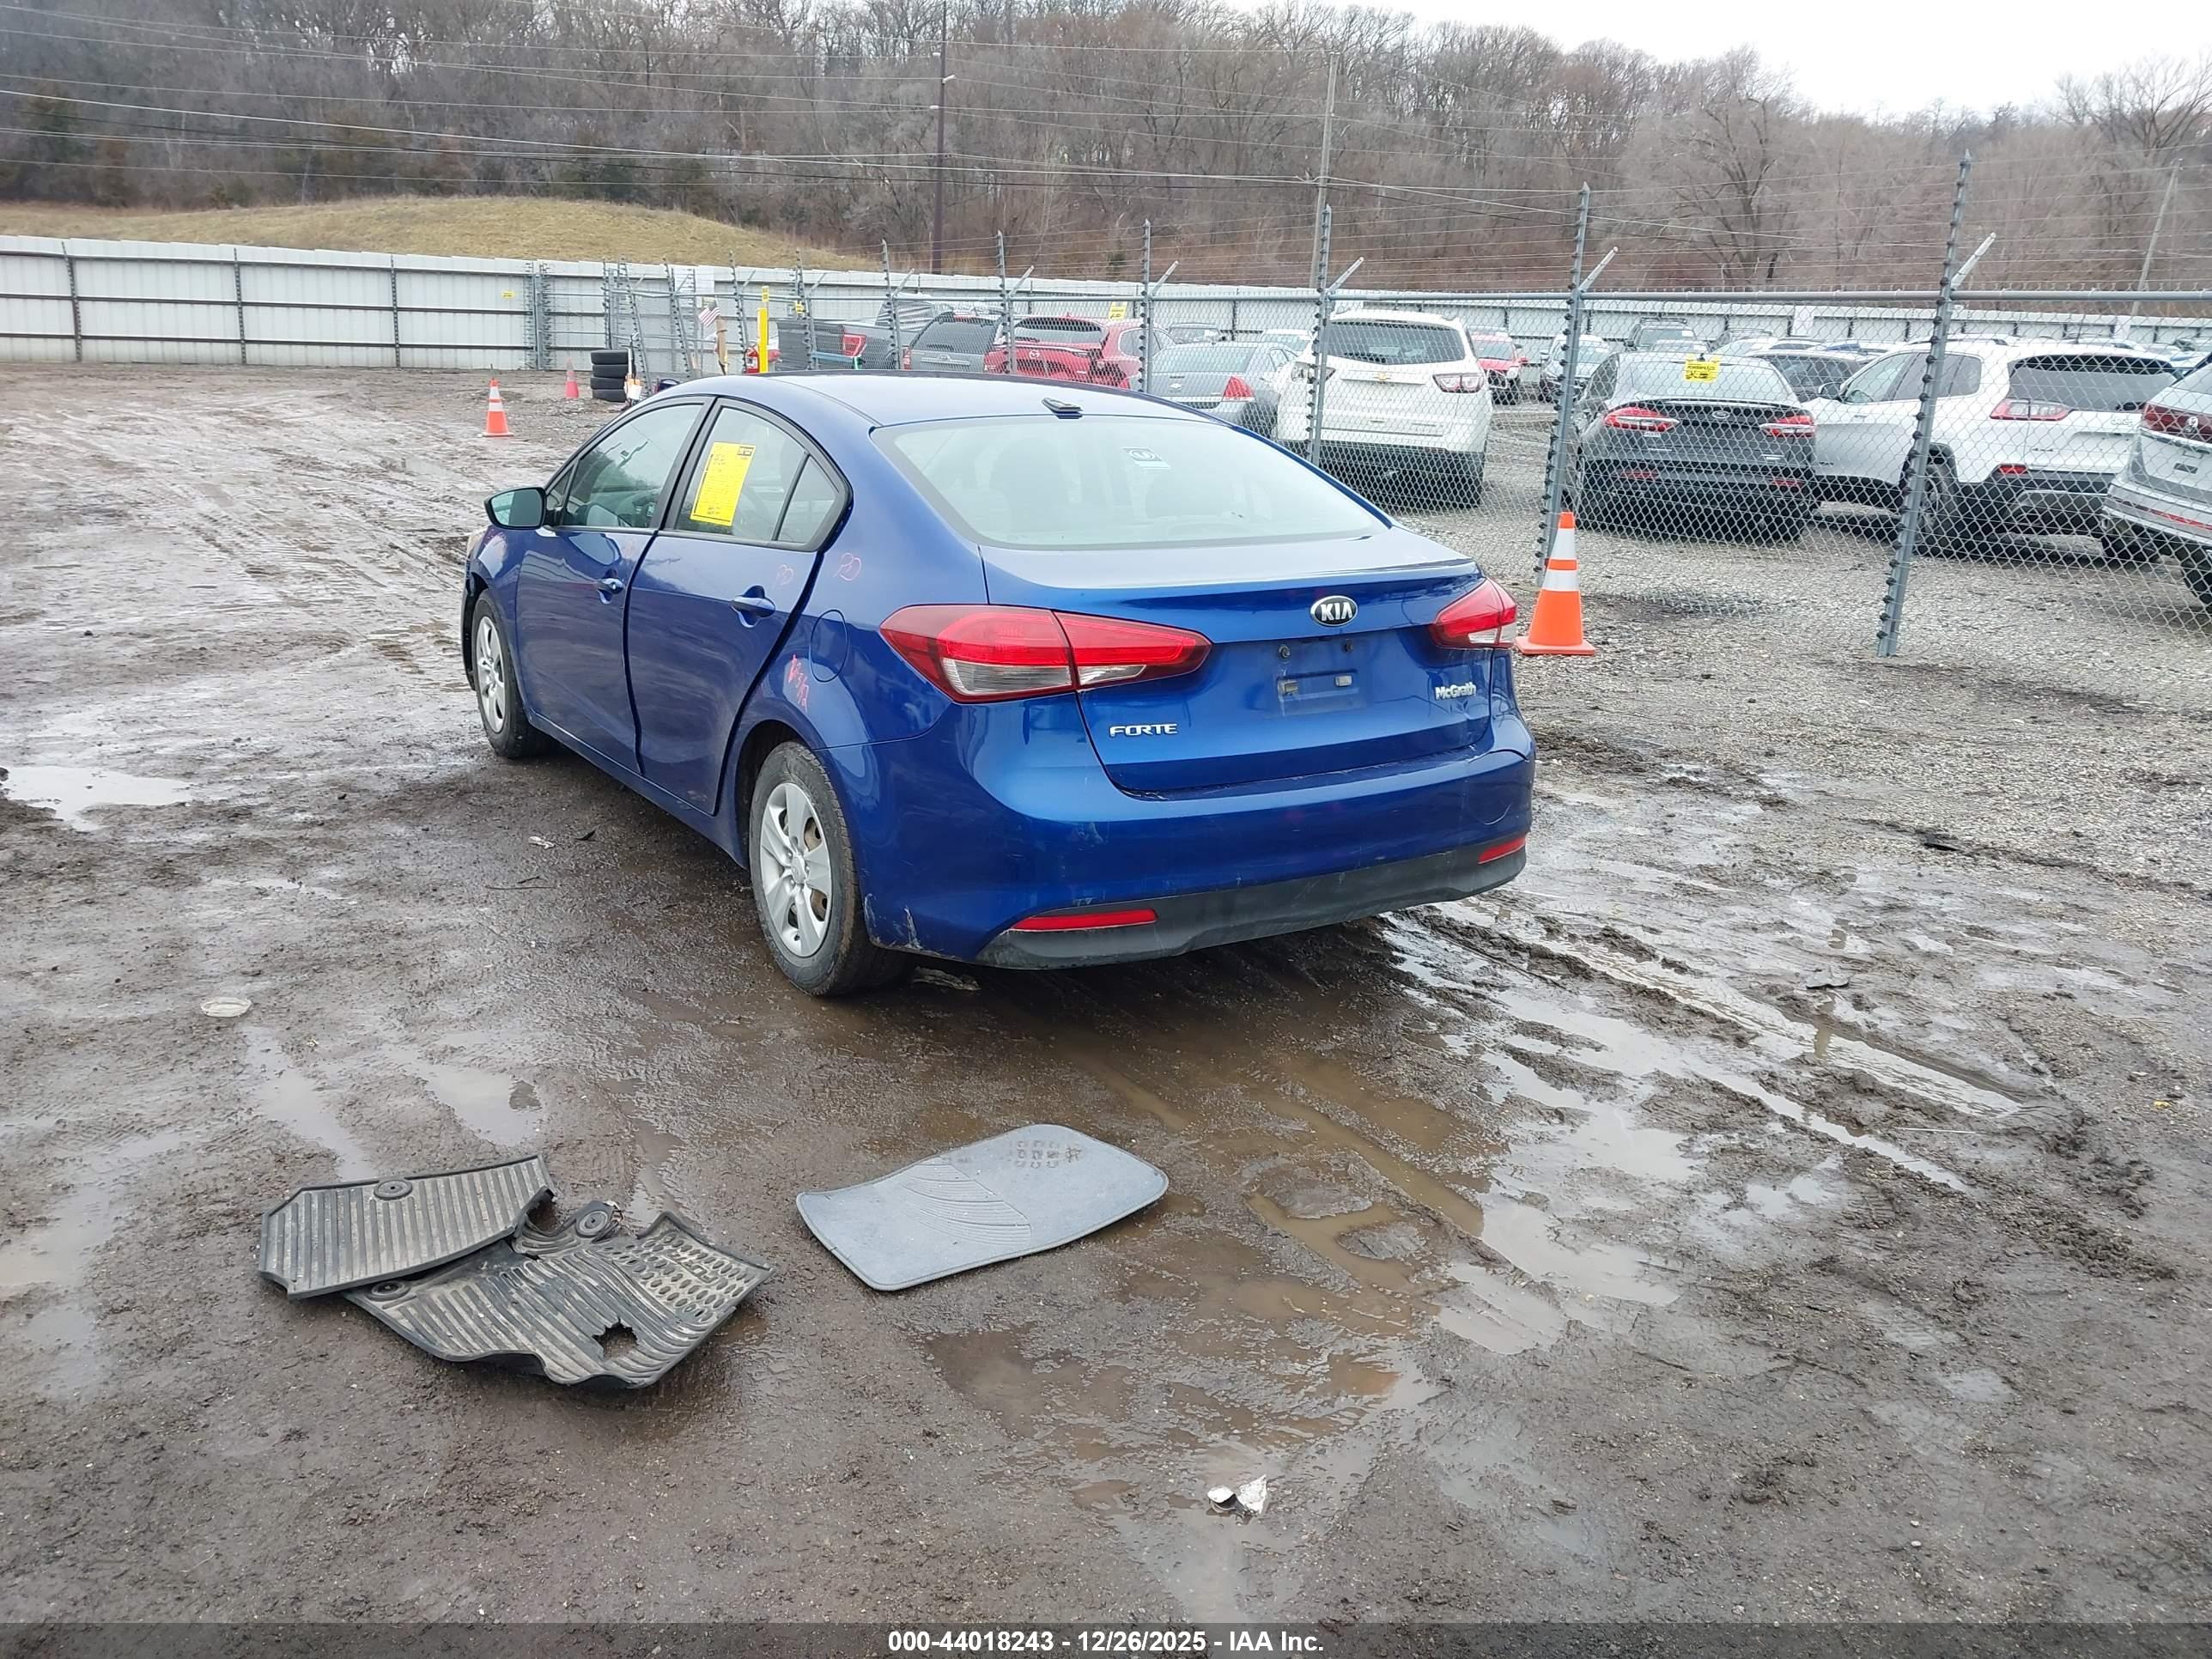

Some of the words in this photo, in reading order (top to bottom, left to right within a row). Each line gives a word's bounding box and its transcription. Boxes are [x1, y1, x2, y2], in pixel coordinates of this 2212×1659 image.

[1320, 601, 1353, 621] KIA
[1435, 681, 1477, 701] McGrath
[1109, 723, 1177, 738] FORTE
